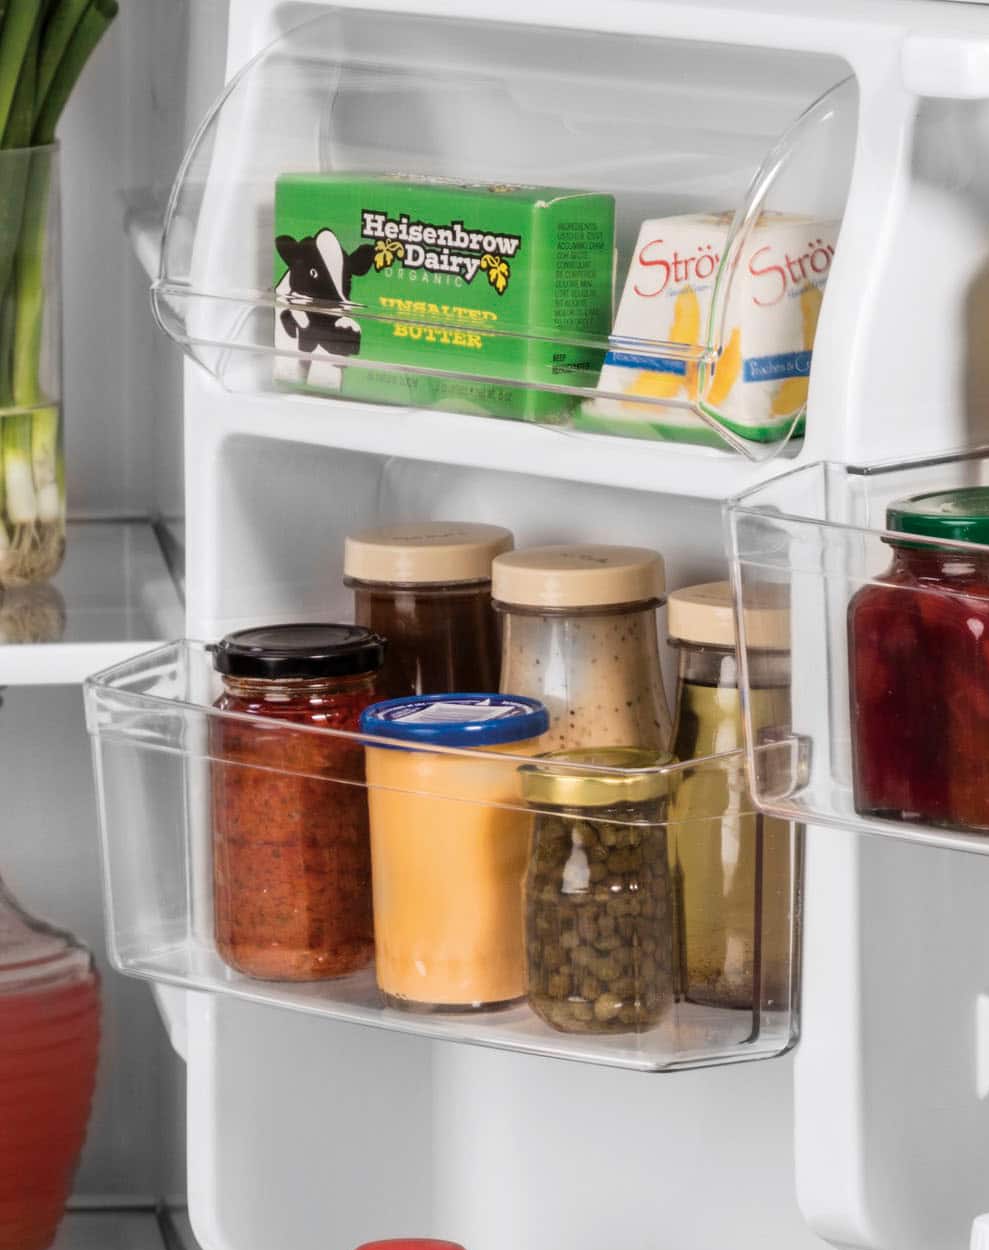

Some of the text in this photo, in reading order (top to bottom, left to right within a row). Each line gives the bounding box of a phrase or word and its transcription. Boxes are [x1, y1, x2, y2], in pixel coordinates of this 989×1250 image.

[362, 211, 520, 256] Heisenbrow
[384, 267, 464, 288] ORGANIC
[403, 243, 481, 281] Dairy
[393, 323, 483, 349] BUTTER
